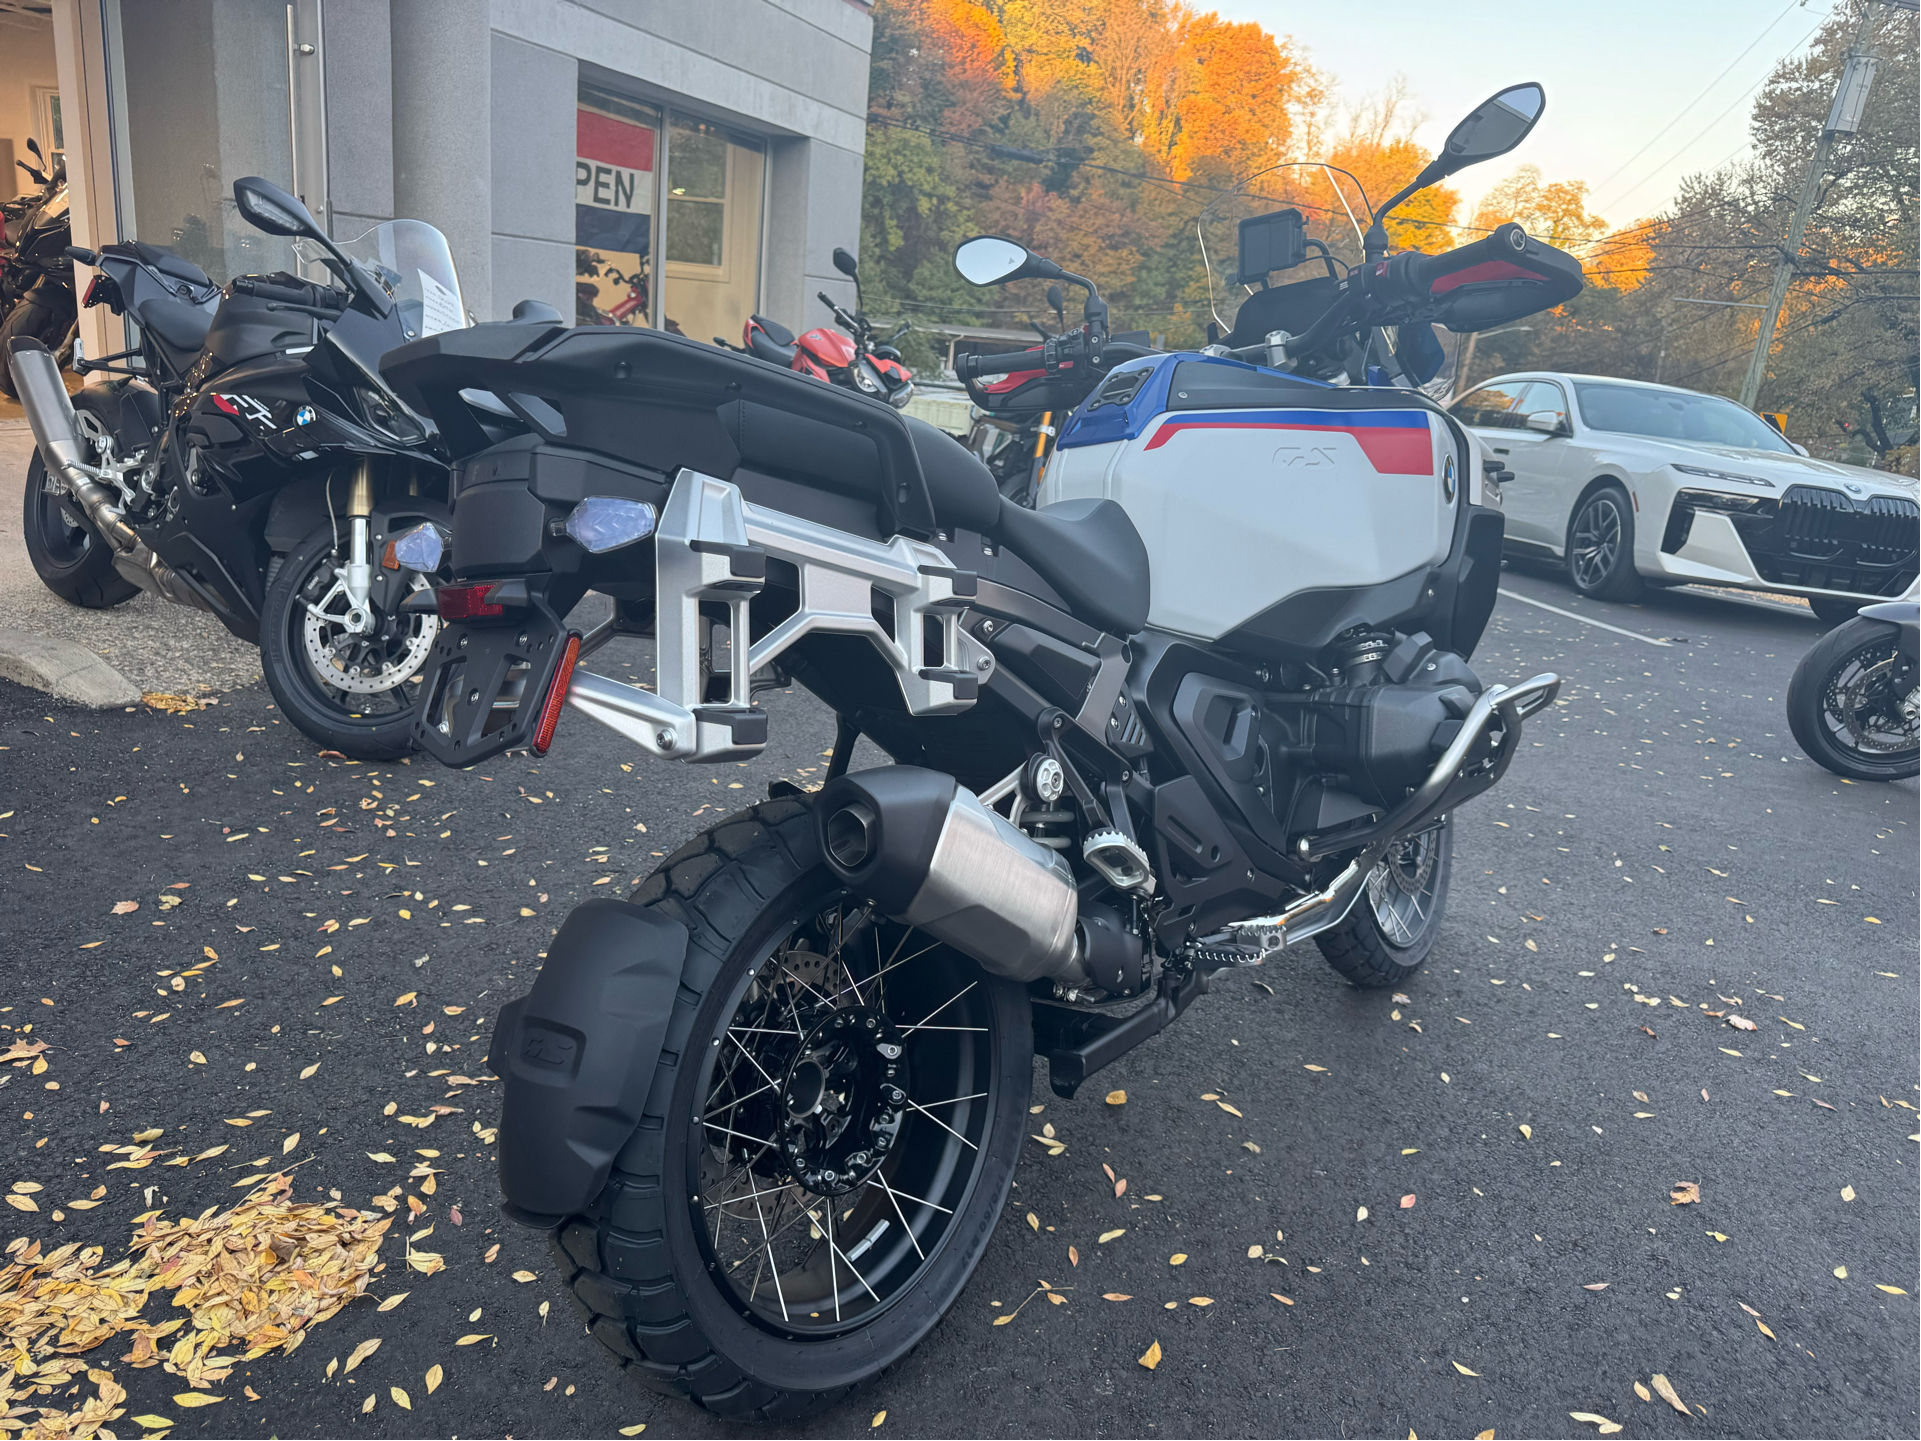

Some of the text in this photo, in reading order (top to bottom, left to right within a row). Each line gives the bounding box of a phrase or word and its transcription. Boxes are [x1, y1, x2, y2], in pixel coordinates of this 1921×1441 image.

[575, 161, 635, 209] PEN
[978, 1173, 1005, 1233] 170/60
[961, 1247, 973, 1270] 17
